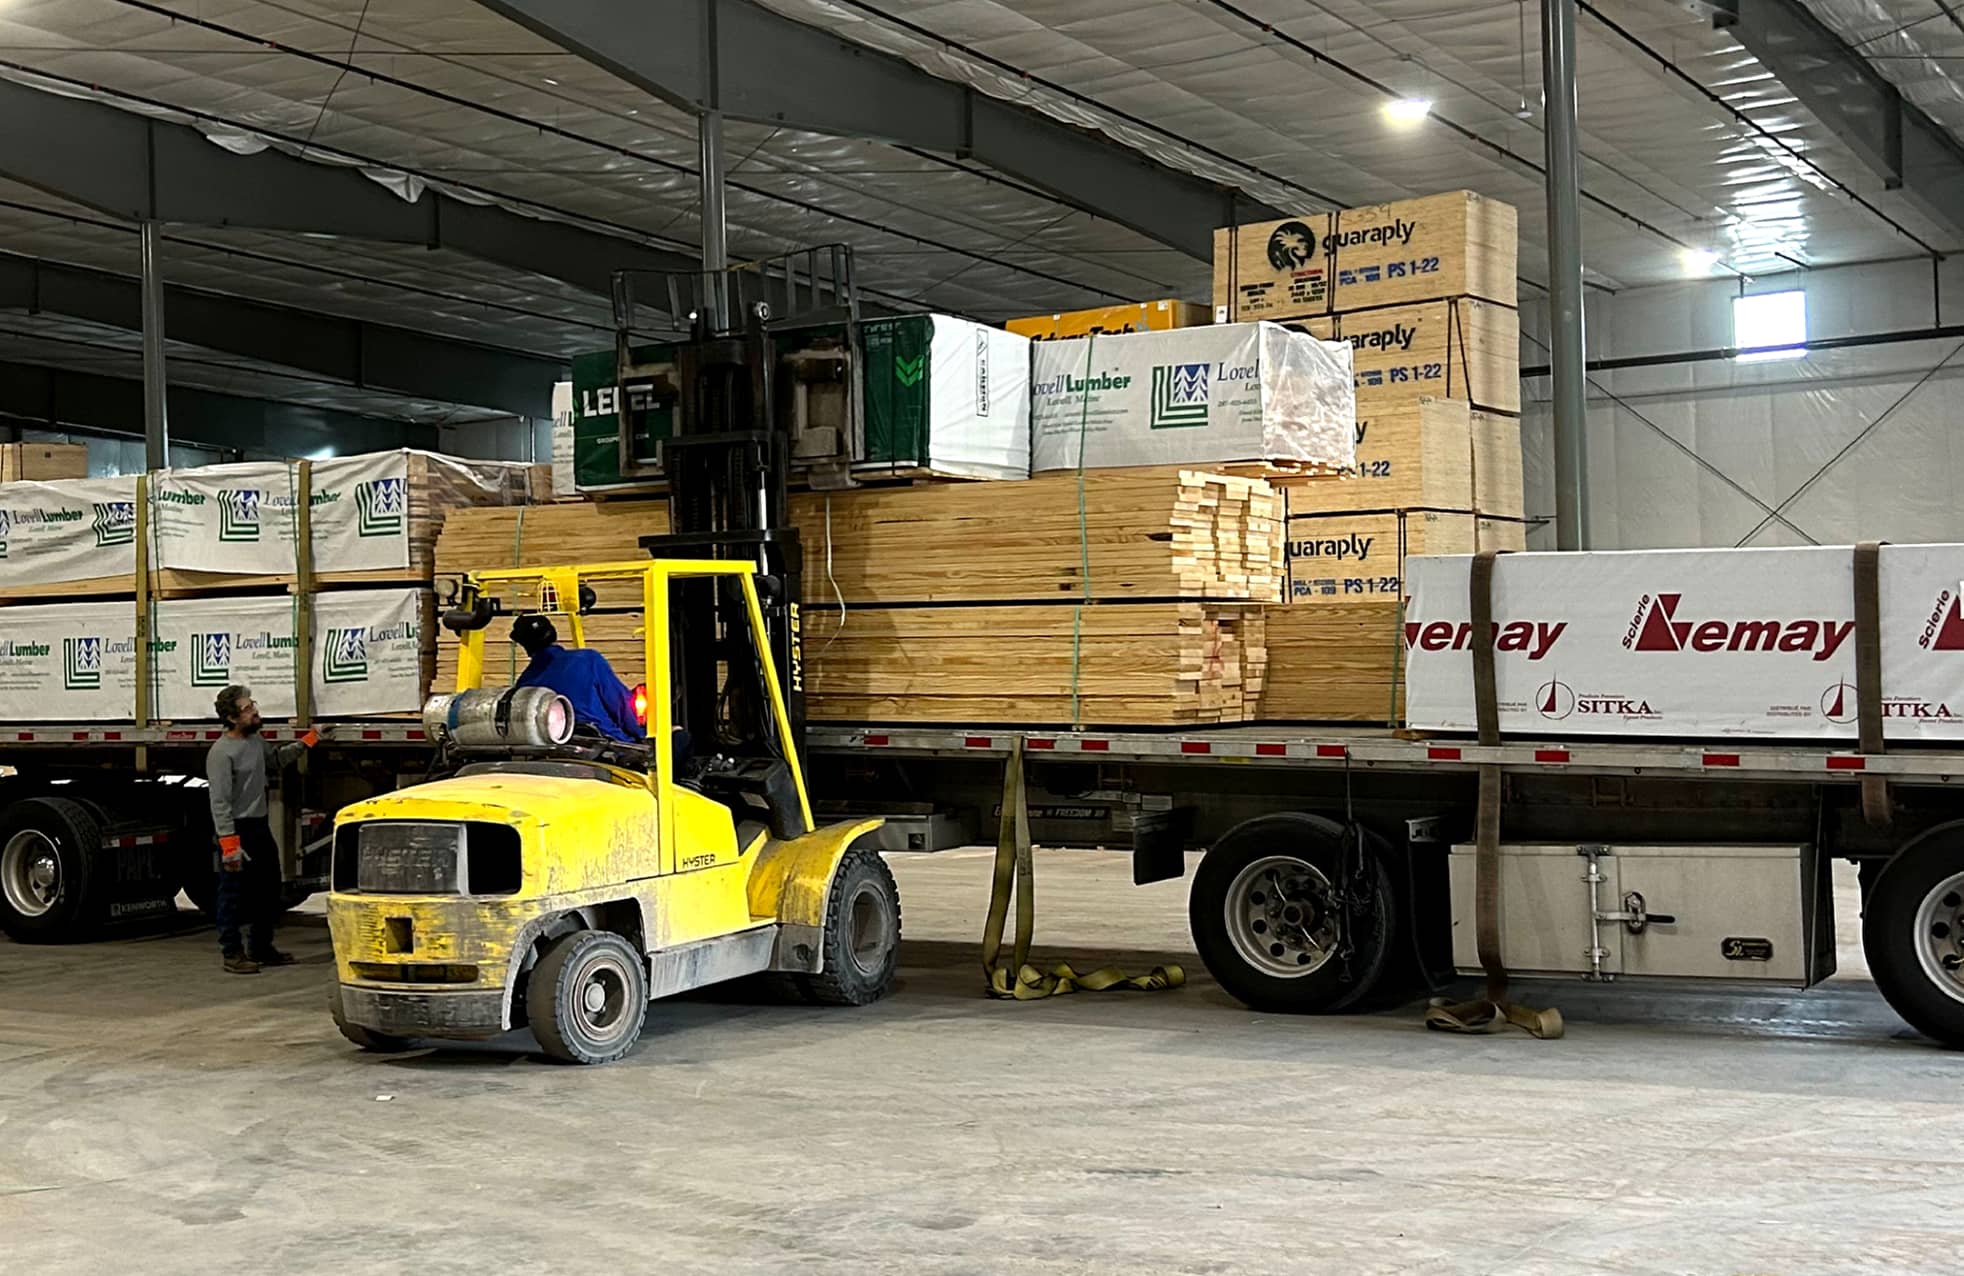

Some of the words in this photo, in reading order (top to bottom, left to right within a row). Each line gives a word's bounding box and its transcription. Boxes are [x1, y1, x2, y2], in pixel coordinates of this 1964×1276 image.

[1387, 261, 1406, 278] PS
[1410, 257, 1439, 275] 1-22
[1343, 323, 1416, 351] araply
[1217, 358, 1260, 381] Lovel
[1390, 366, 1408, 383] PS
[1411, 363, 1441, 380] 1-22
[1033, 374, 1065, 395] ovell
[1360, 461, 1390, 477] 1-22
[1344, 579, 1363, 594] PS
[1367, 577, 1399, 593] 1-22
[1622, 594, 1650, 650] Scierie
[1918, 589, 1950, 649] Scierie
[267, 632, 300, 648] Lumb
[790, 602, 802, 692] HYSTER
[1405, 621, 1567, 660] emay
[1578, 700, 1653, 714] SITKA
[1882, 703, 1947, 717] ITKA
[682, 854, 716, 868] HYSTER
